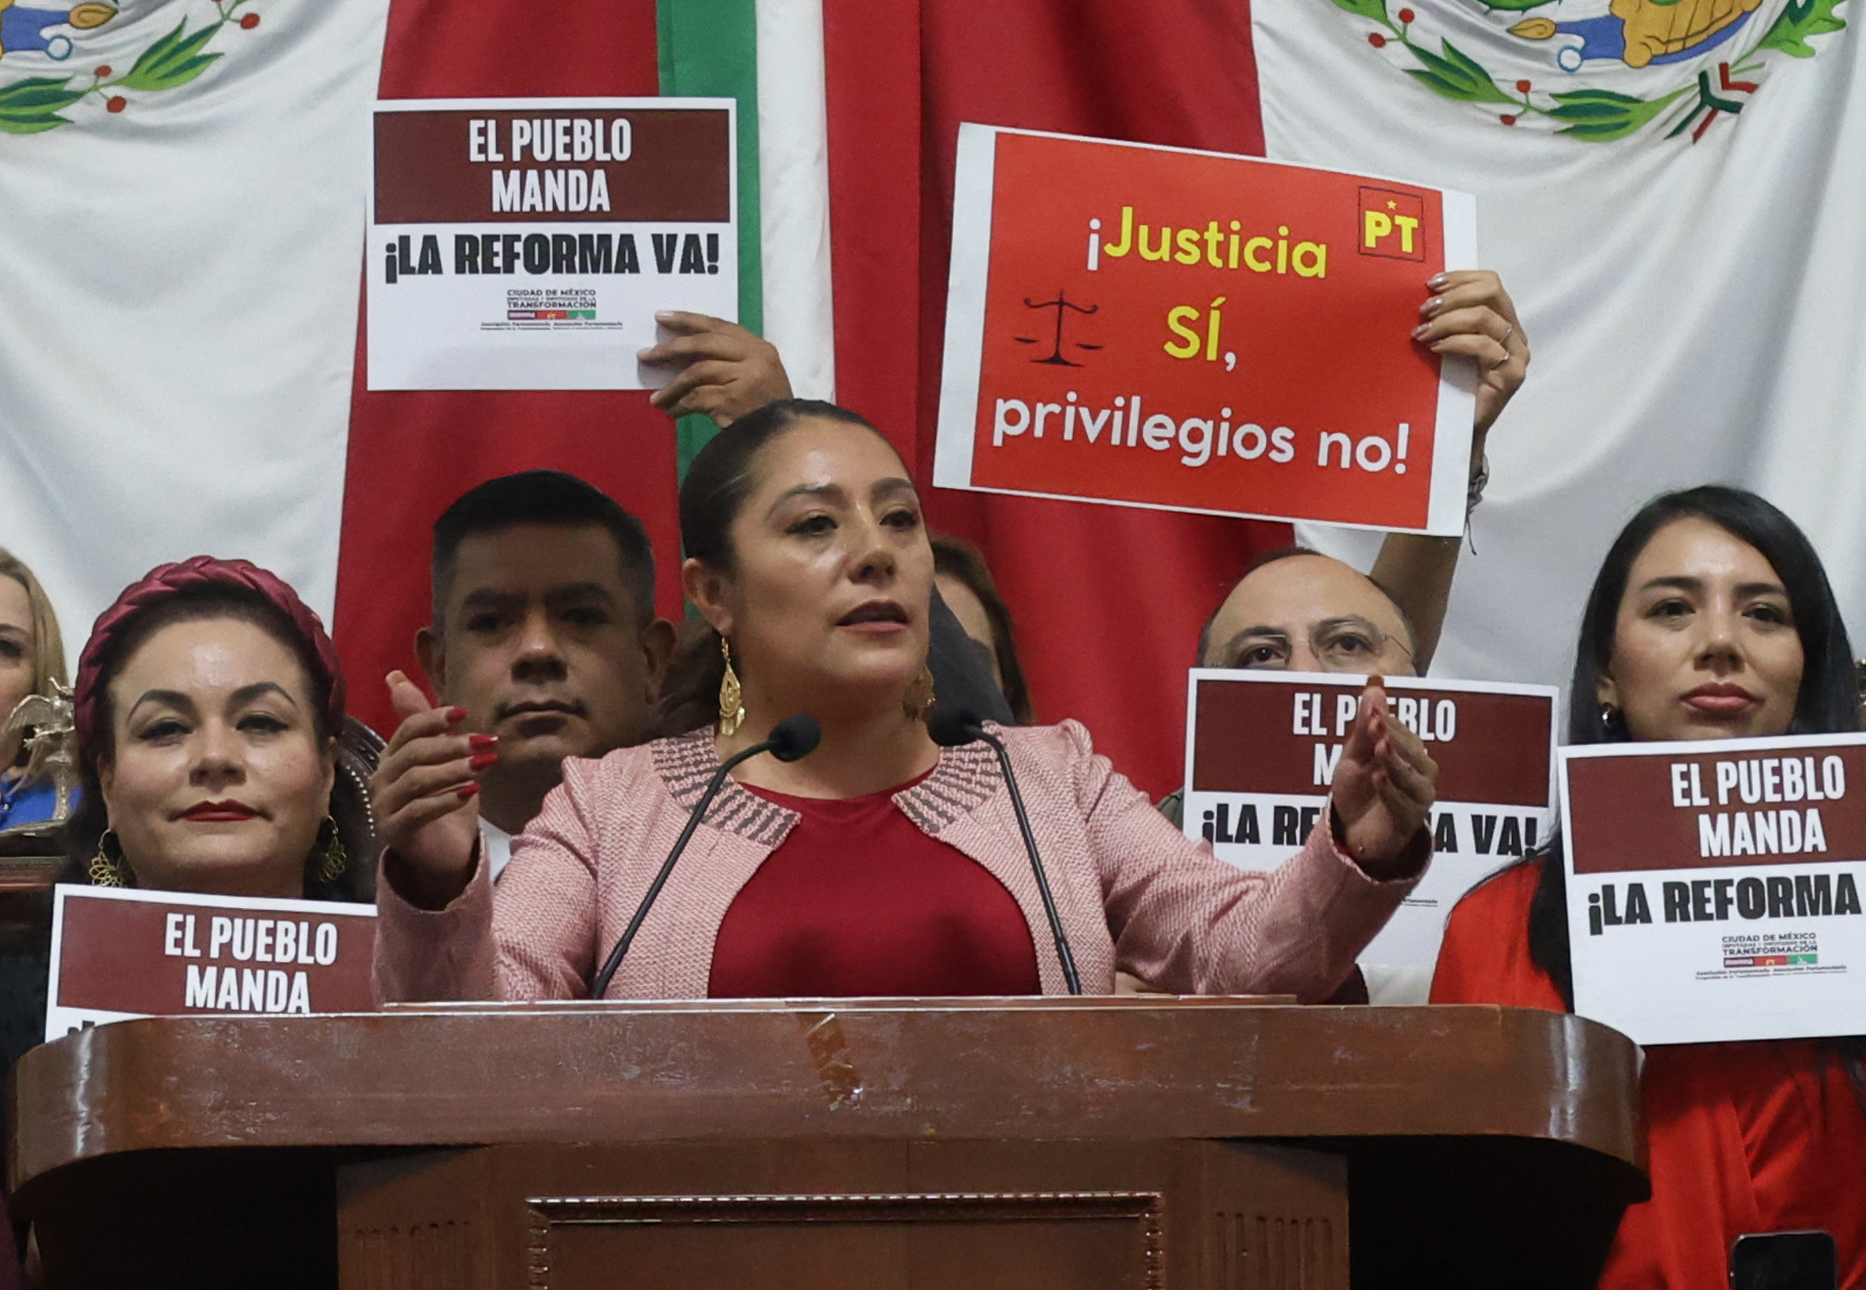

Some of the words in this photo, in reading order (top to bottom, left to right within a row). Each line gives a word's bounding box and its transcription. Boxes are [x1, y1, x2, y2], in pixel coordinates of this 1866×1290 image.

[470, 120, 503, 161] EL
[513, 119, 631, 161] PUEBLO
[493, 170, 610, 212] MANDA
[1087, 206, 1328, 278] ¡Justicia
[1364, 209, 1419, 254] PT
[386, 235, 442, 283] ¡LA
[455, 234, 640, 274] REFORMA
[652, 234, 718, 274] VA!
[561, 288, 596, 296] MÉXICO
[1163, 297, 1237, 371] SÍ,
[993, 391, 1295, 468] privilegios
[1318, 422, 1410, 474] no!
[1294, 693, 1327, 735] EL
[1336, 695, 1455, 741] PBLO
[1672, 764, 1709, 806] EL
[1717, 756, 1844, 804] PUEBLO
[1202, 804, 1260, 853] ¡LA
[1471, 815, 1537, 854] VA!
[1699, 809, 1826, 857] MANDA
[1589, 883, 1652, 935] ¡LA
[1663, 874, 1861, 922] REFORMA
[1722, 935, 1760, 943] CIUDAD
[1779, 932, 1816, 940] MÉXICO
[1723, 945, 1817, 956] TRANSFORMACIÓN
